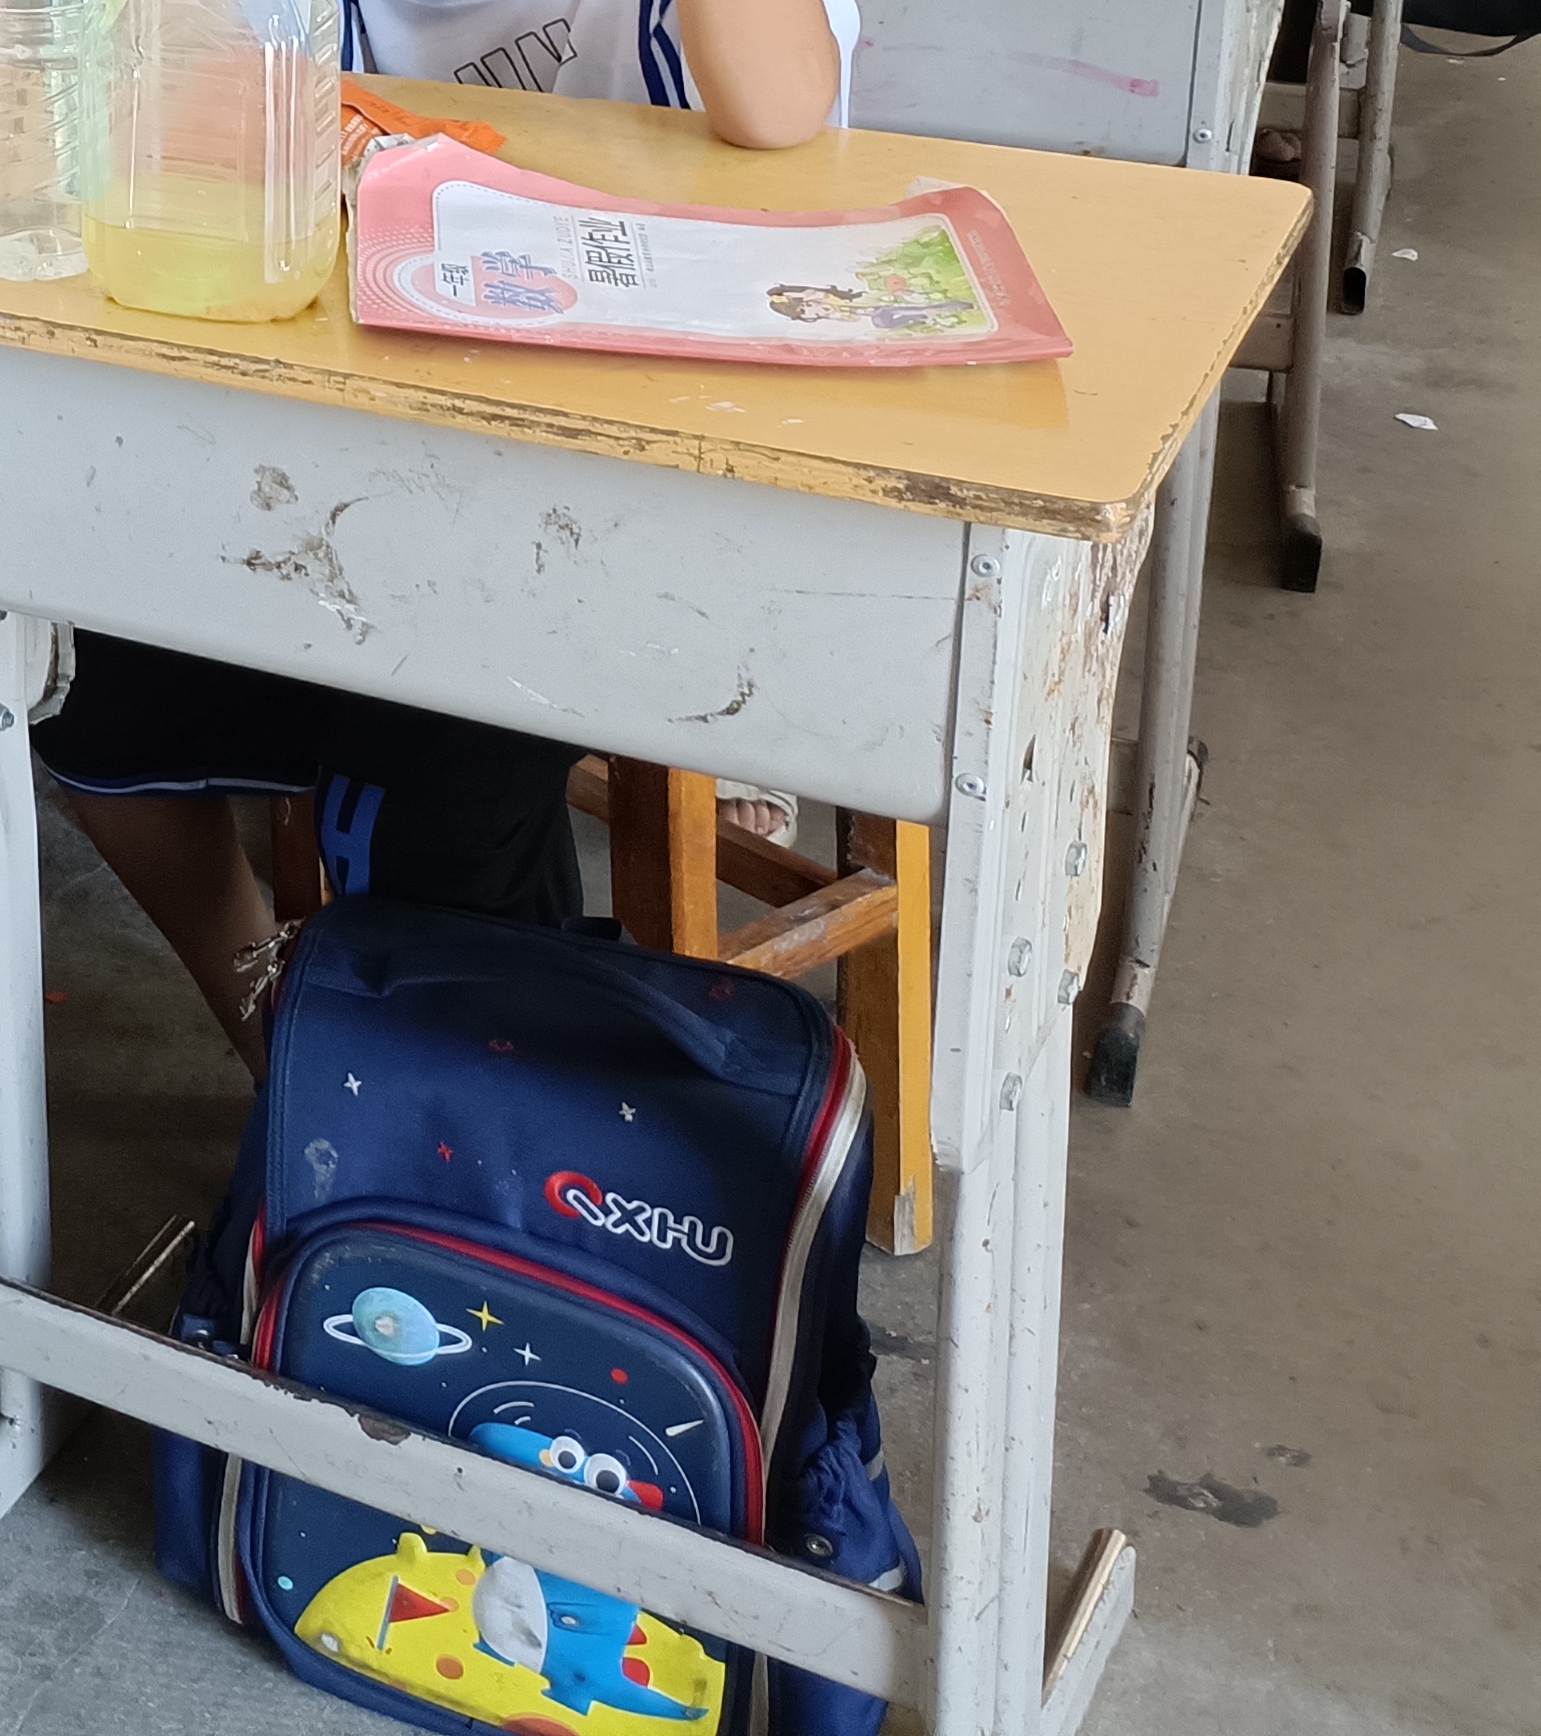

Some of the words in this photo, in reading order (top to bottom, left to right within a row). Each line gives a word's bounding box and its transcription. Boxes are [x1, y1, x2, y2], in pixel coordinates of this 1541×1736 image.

[481, 249, 564, 314] 数学
[578, 216, 639, 288] 暑假作业
